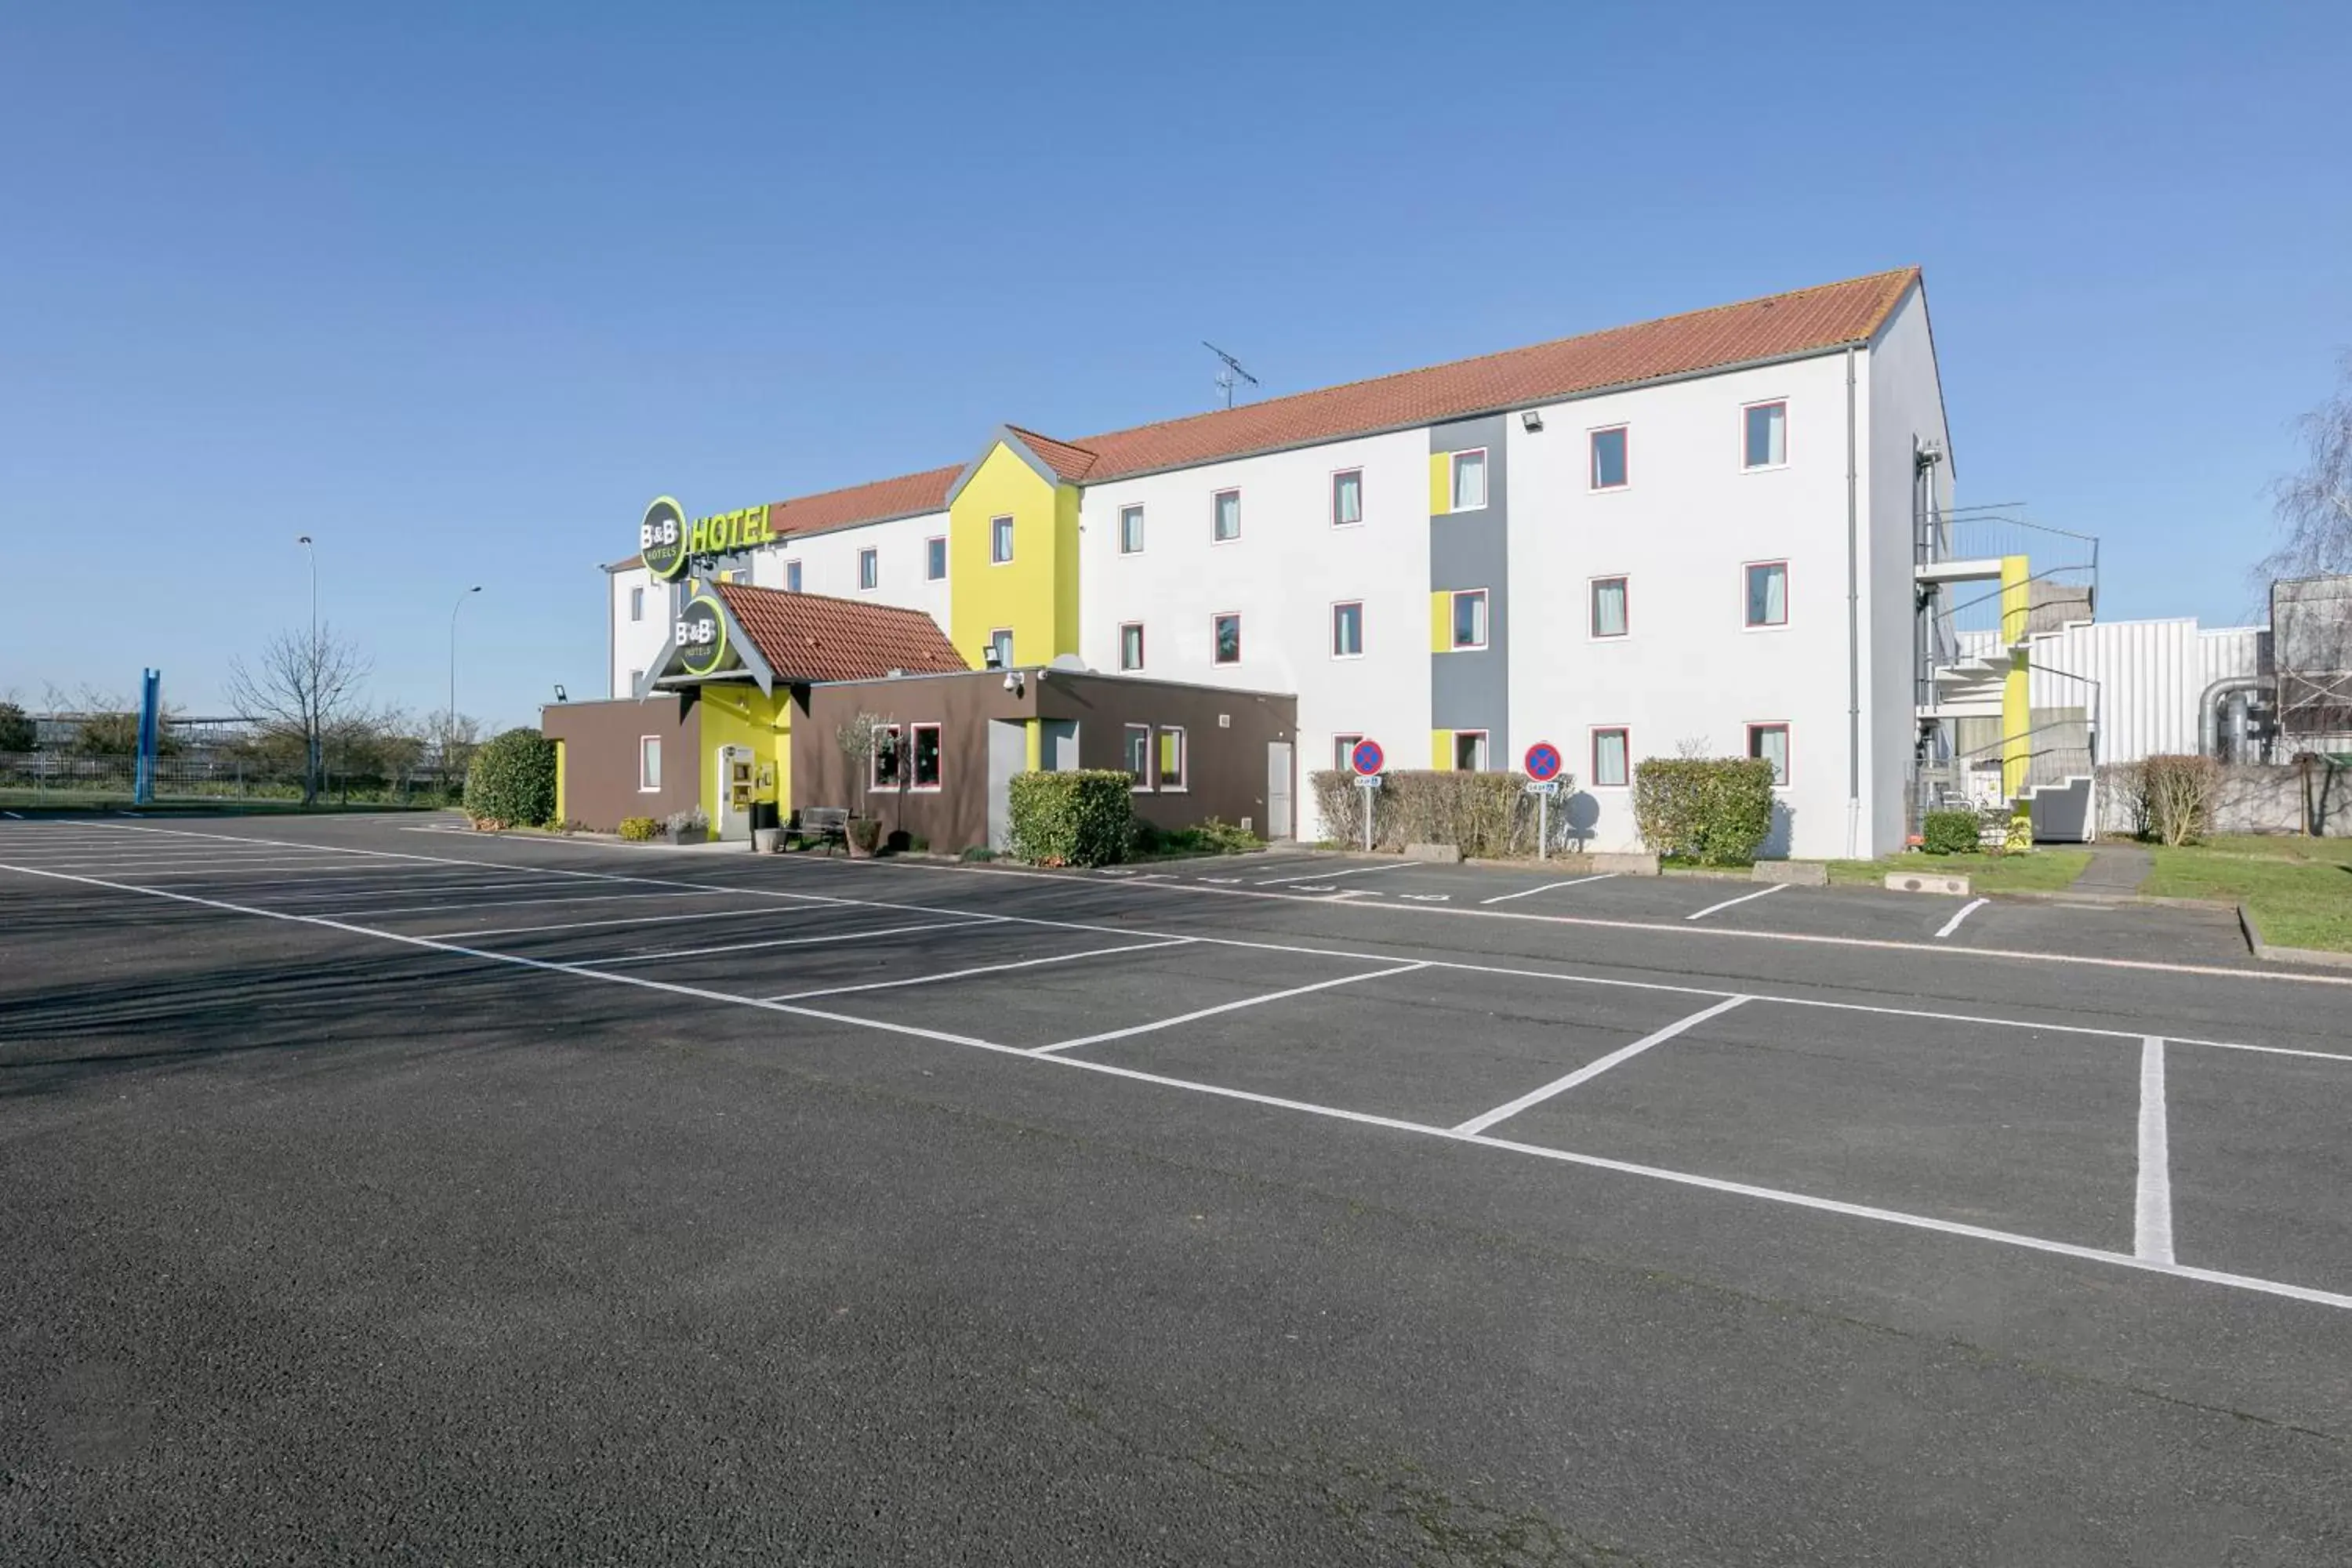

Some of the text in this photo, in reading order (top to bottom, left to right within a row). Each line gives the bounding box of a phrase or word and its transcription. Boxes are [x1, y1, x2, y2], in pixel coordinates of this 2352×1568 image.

[641, 520, 678, 550] B&B
[692, 504, 777, 552] HOTEL
[676, 619, 715, 646] B&B
